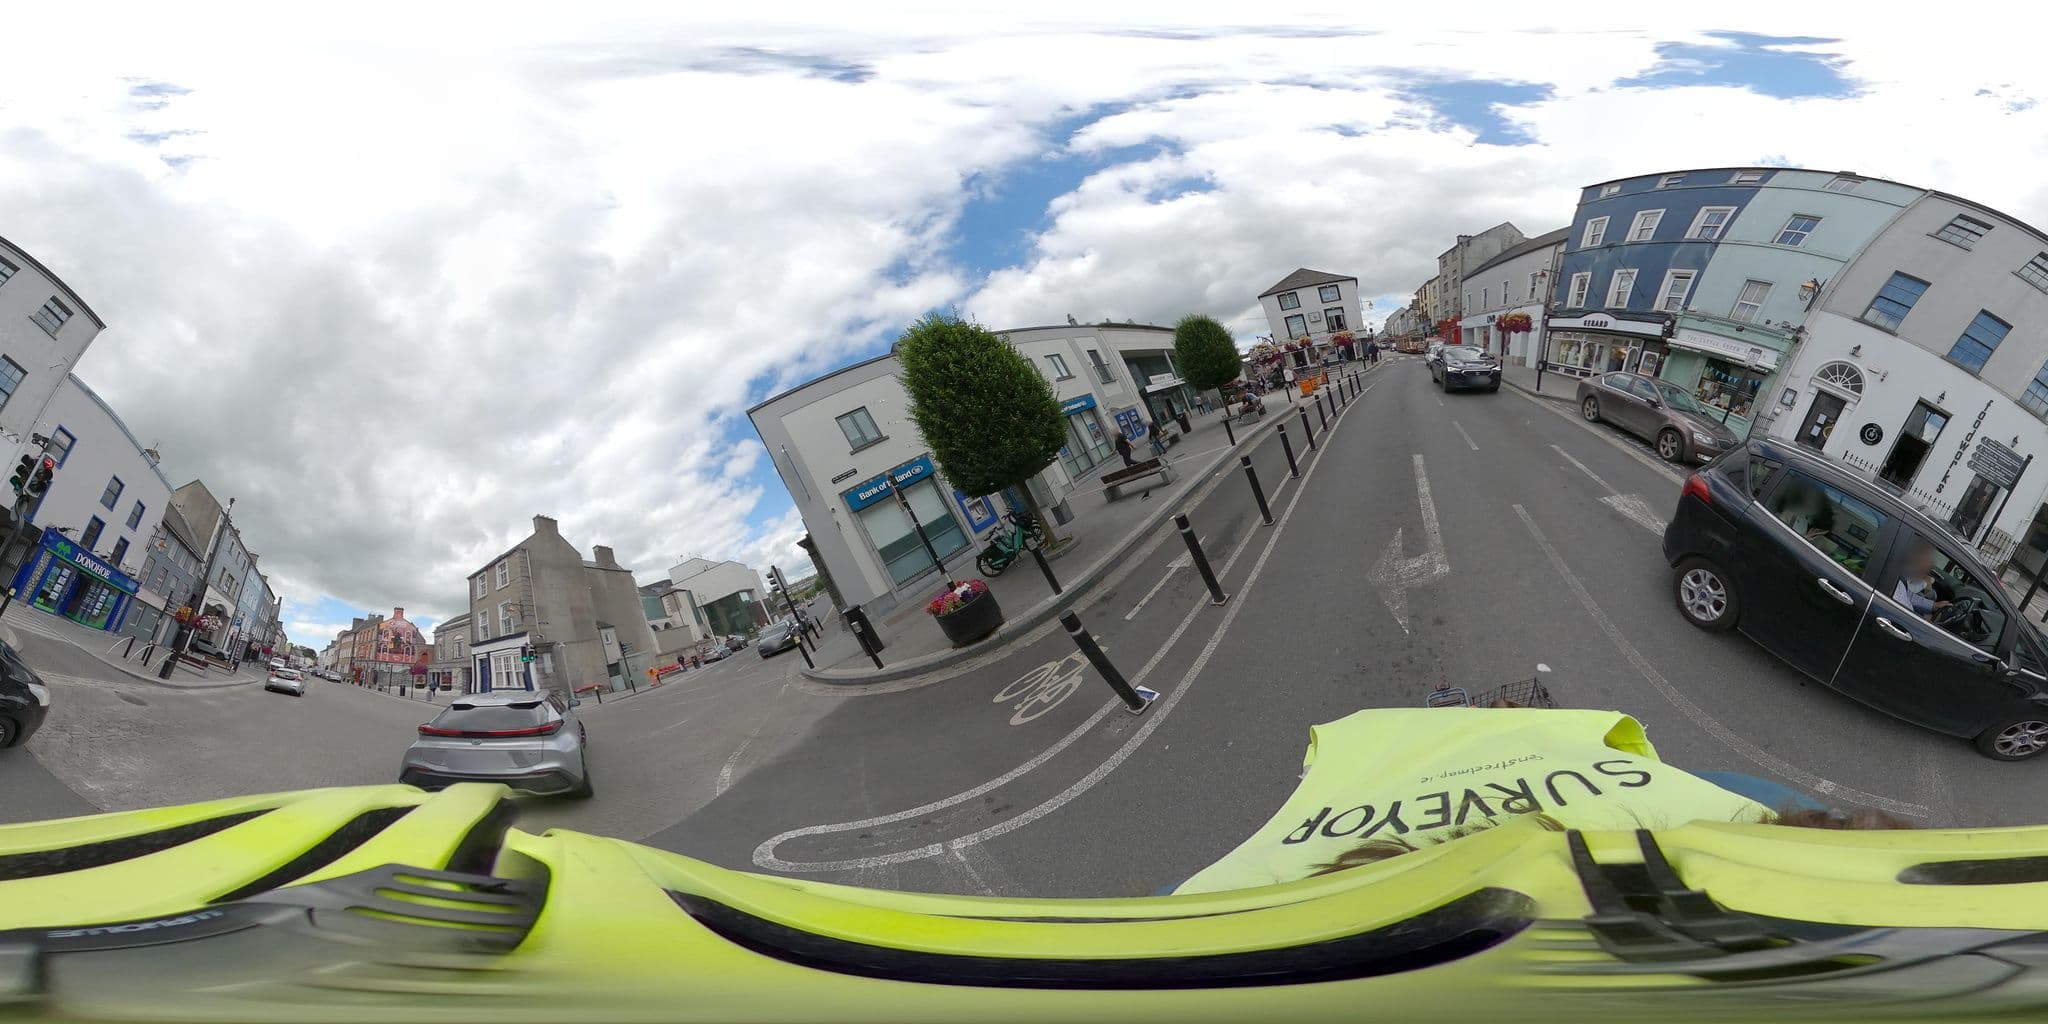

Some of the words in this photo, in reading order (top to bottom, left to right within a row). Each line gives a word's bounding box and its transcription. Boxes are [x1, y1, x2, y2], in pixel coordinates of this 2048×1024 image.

[1935, 398, 1994, 494] foodworks
[858, 486, 880, 501] Bank
[878, 482, 888, 491] of
[886, 470, 913, 487] Iland
[75, 552, 111, 580] DONOHOE
[1420, 754, 1544, 784] enstreetmap.ie
[1281, 760, 1651, 845] SURVEYOR
